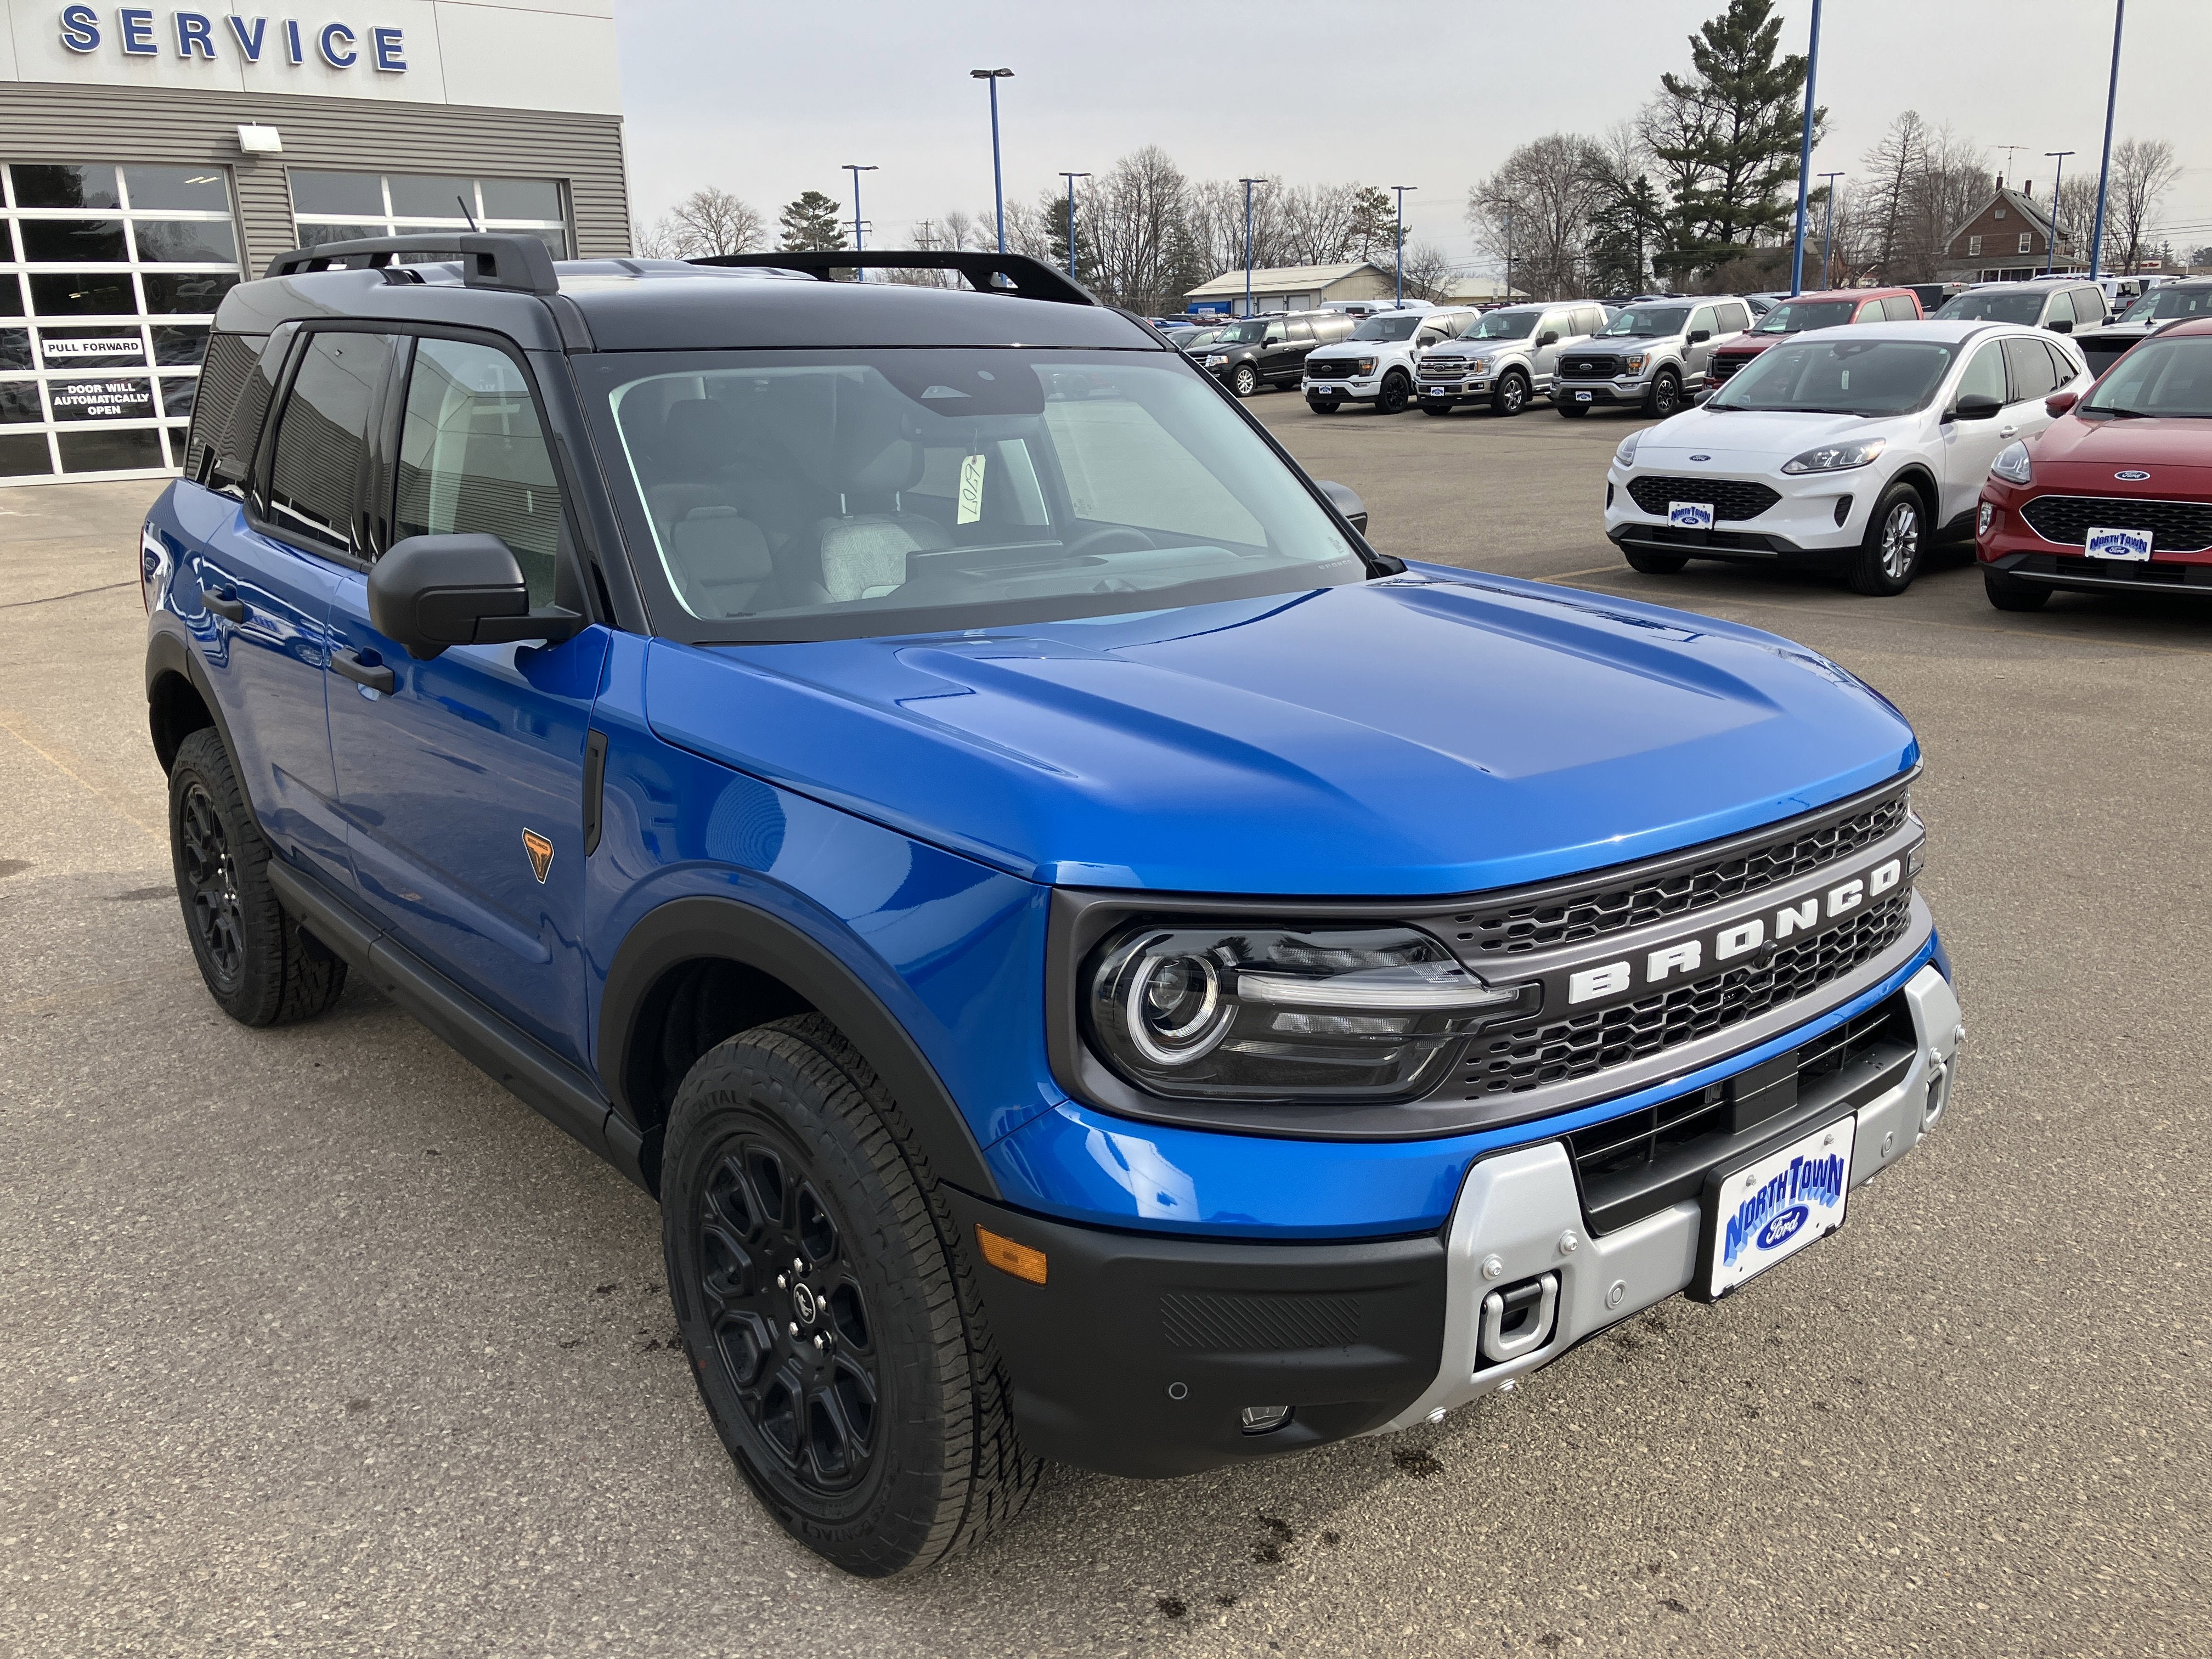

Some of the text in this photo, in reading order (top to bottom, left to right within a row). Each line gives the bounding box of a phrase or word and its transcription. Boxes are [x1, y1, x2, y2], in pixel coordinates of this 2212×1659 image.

[61, 3, 408, 72] SERVICE
[48, 343, 139, 352] PULL FORWARD
[67, 383, 136, 394] DOOR WILL
[54, 393, 149, 405] AUTOMATICALLY
[87, 405, 121, 415] OPEN
[1568, 859, 1901, 1005] BRONCO
[1765, 1210, 1801, 1245] Ford
